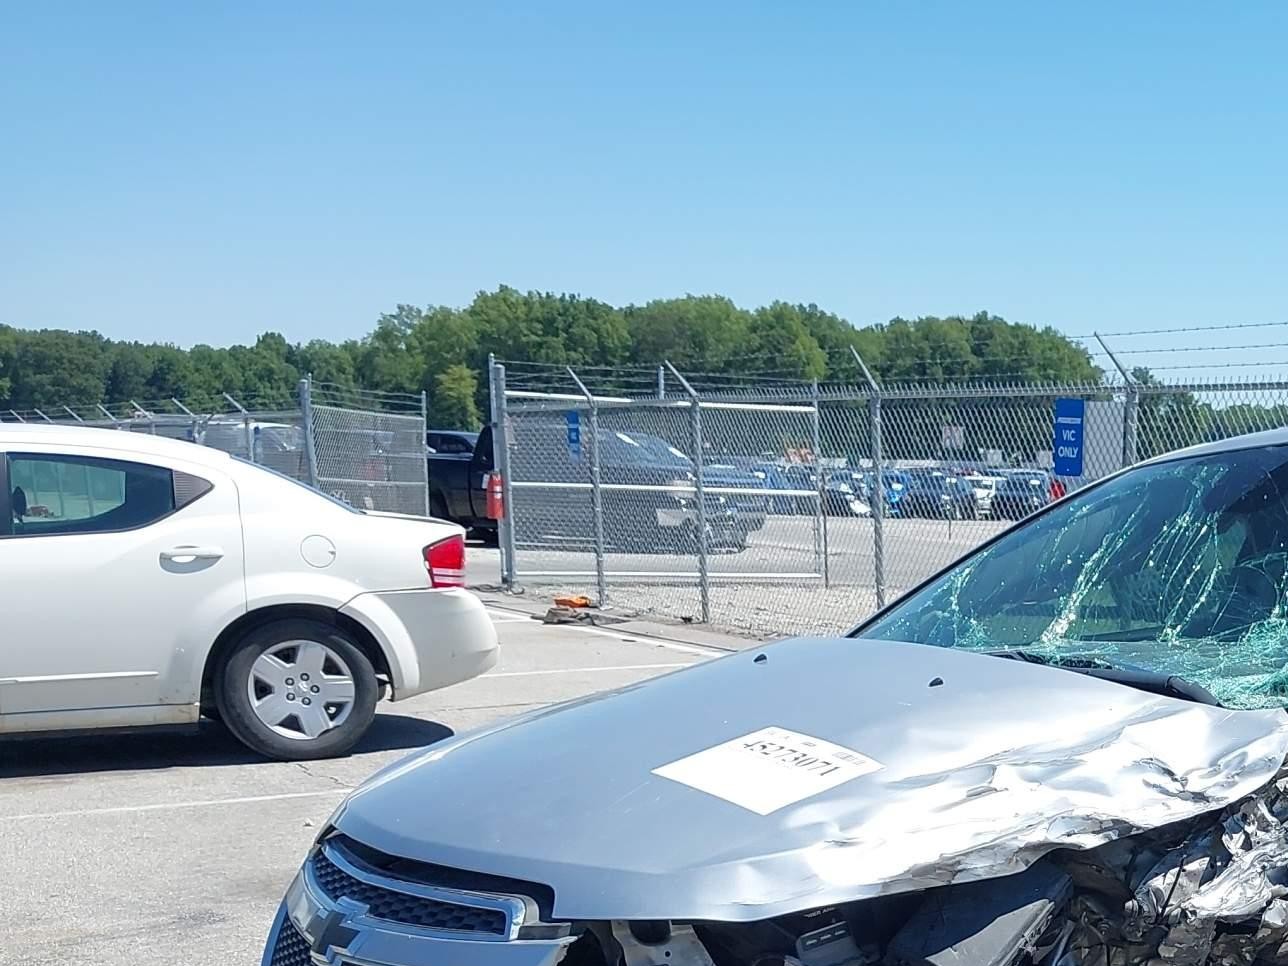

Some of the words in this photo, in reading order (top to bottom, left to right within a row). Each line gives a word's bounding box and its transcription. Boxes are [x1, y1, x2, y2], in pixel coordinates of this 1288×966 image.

[1062, 429, 1077, 442] VIC
[1058, 446, 1079, 458] ONLY
[743, 740, 841, 776] 45273071
